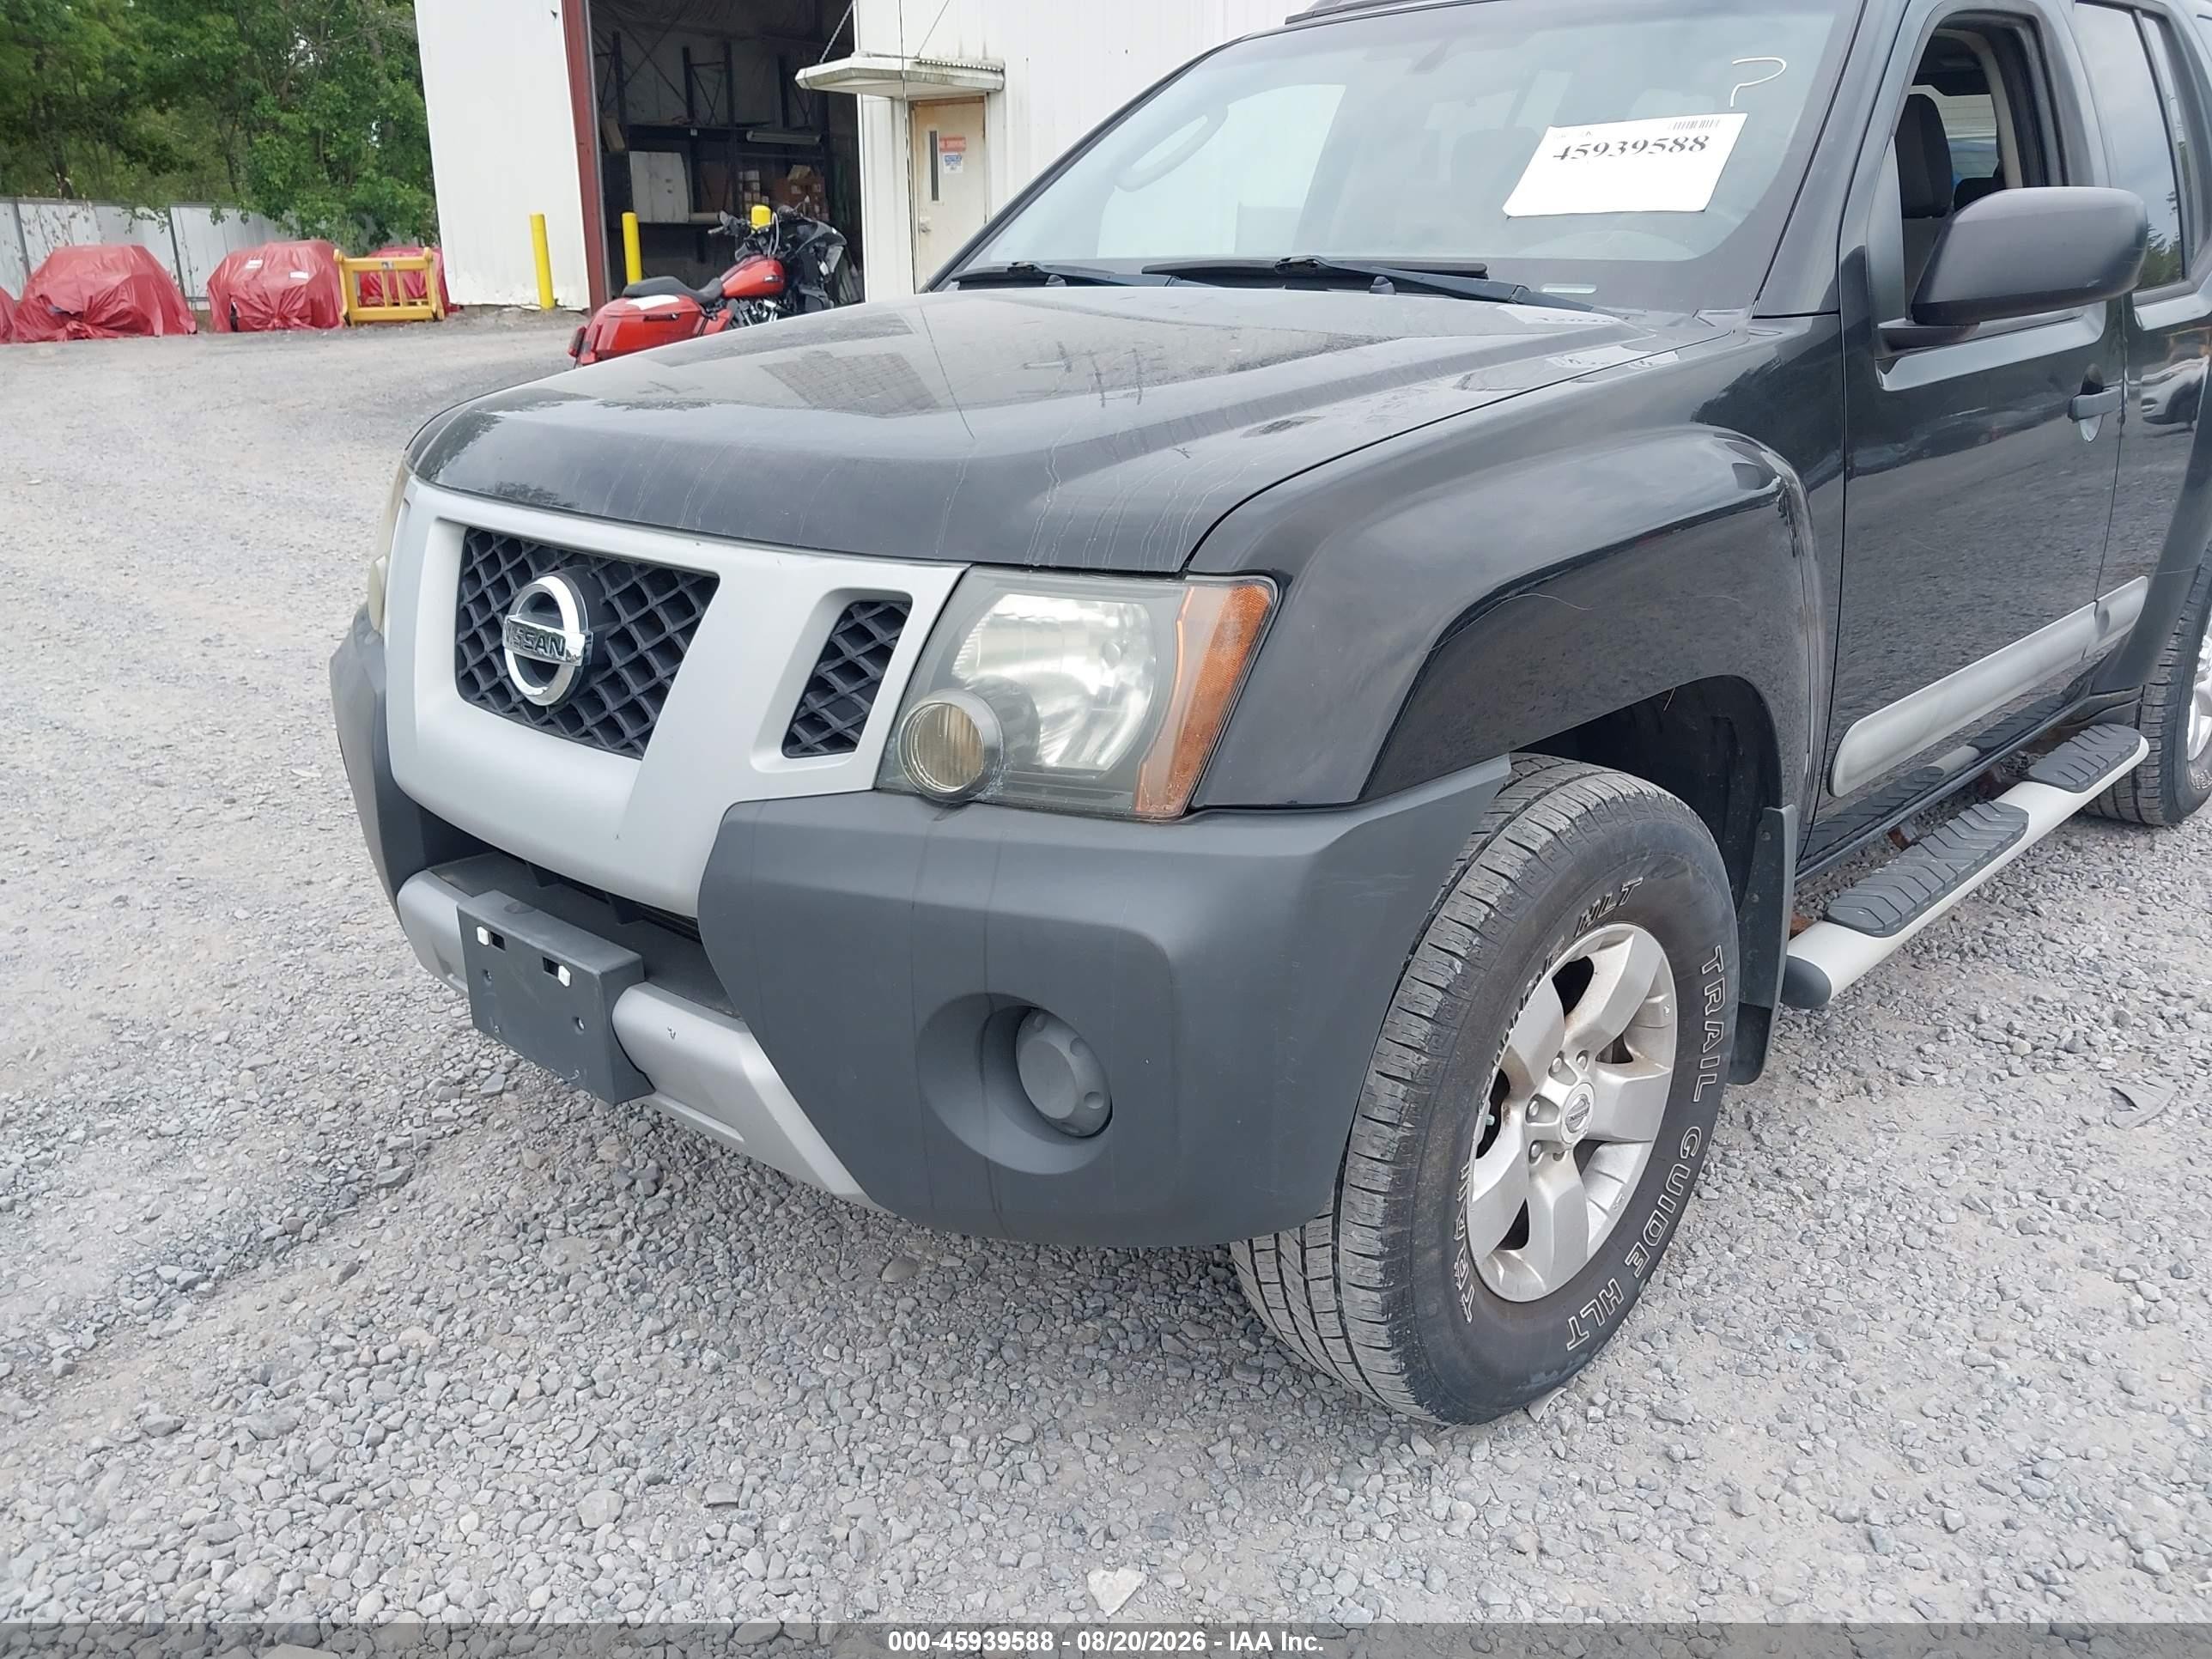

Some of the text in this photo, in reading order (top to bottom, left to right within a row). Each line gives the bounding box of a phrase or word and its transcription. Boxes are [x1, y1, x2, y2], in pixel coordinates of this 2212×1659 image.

[1553, 135, 1710, 161] 45939588
[1566, 945, 1726, 1351] TRAIL GUIDE HLT
